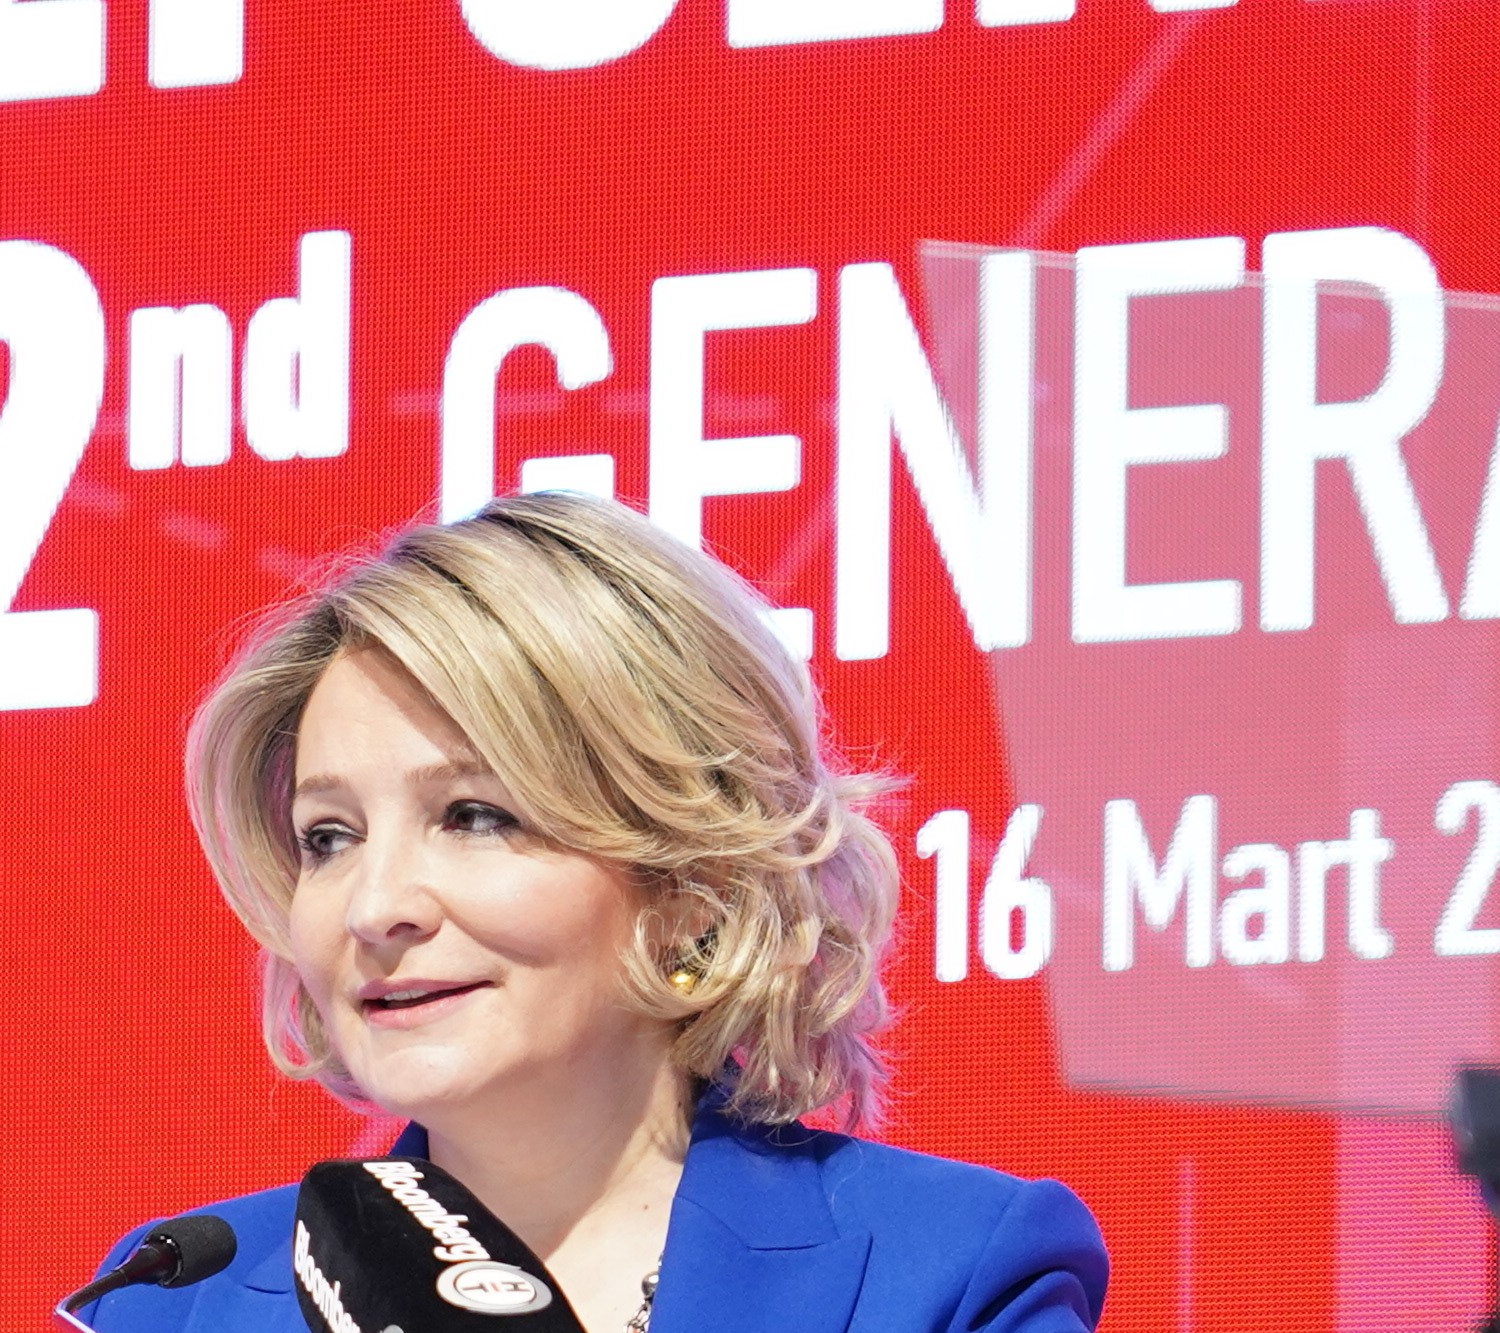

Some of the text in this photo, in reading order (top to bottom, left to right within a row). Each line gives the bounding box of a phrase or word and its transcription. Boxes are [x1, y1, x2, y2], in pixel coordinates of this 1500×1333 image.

[917, 802, 1056, 982] 16
[1101, 793, 1396, 974] Mart
[362, 1161, 491, 1262] Bloomberg
